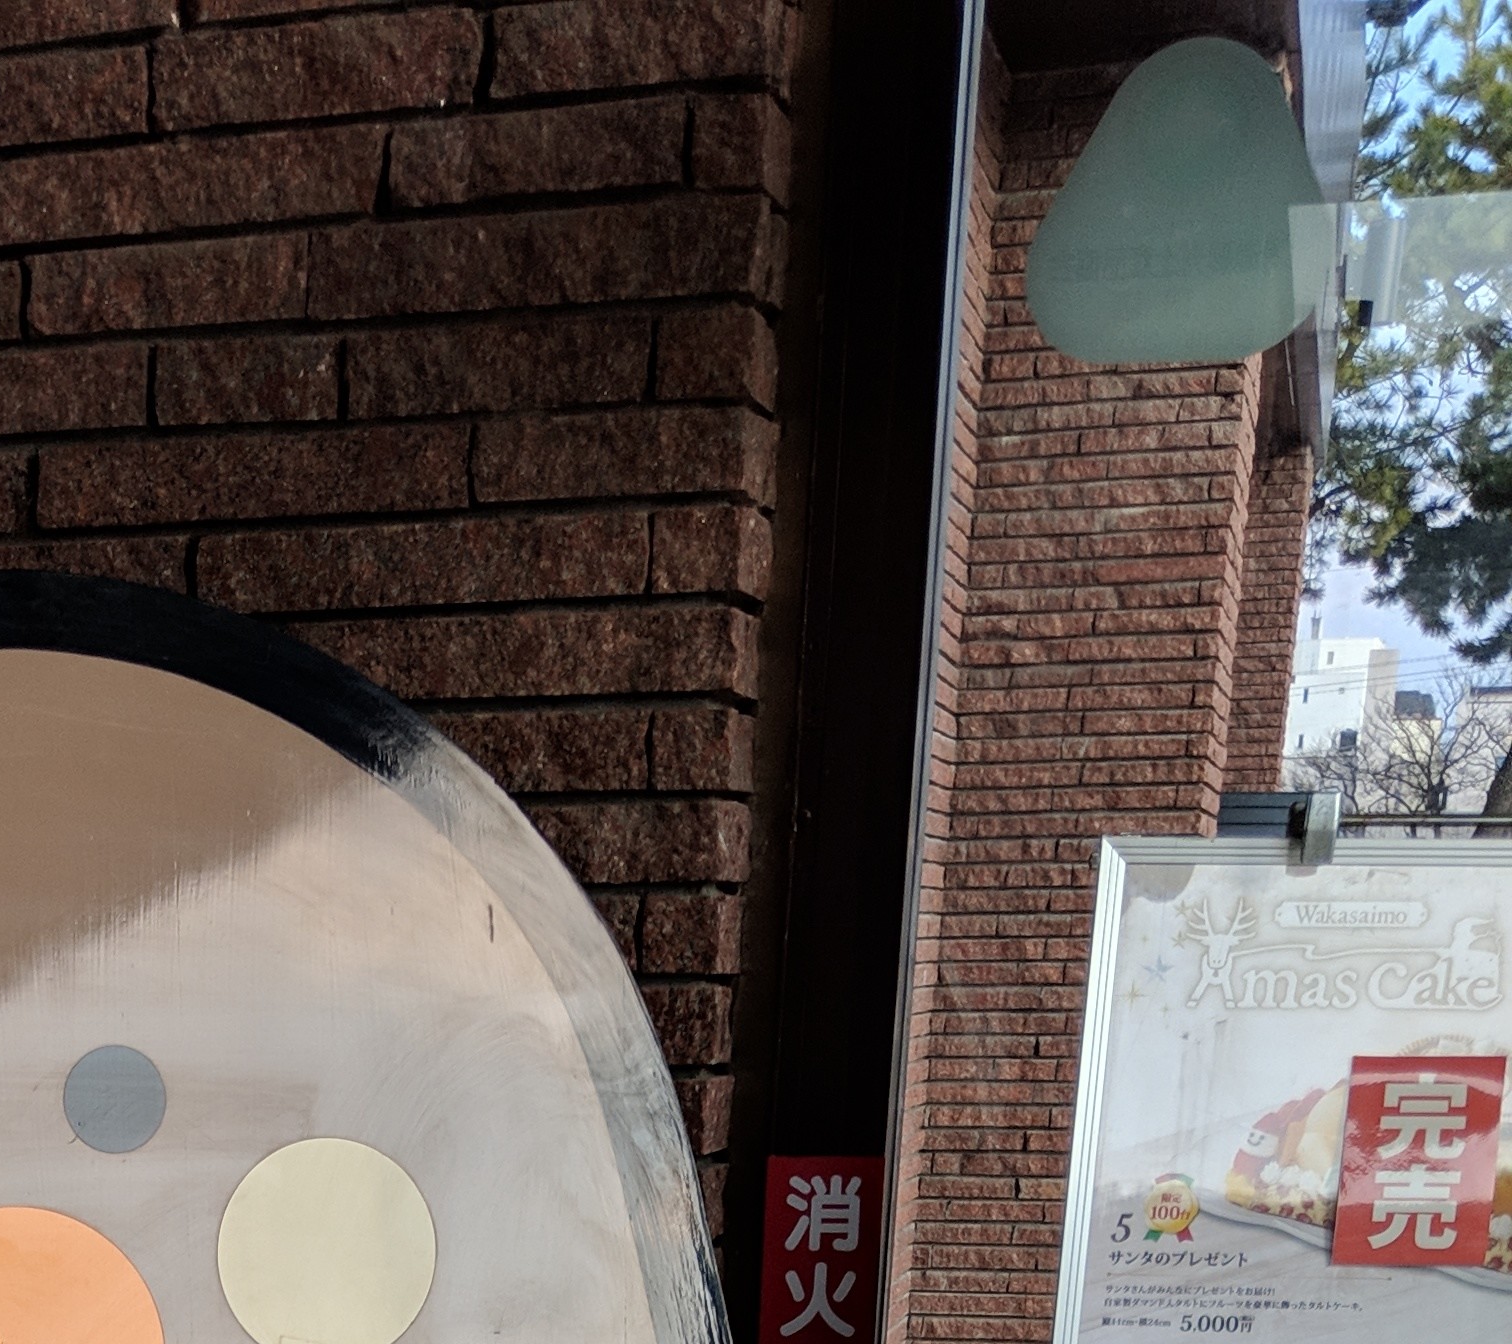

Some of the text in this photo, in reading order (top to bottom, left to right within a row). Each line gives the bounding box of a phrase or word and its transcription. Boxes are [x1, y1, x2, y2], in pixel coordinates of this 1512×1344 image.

[1295, 904, 1408, 925] Wakasaimo
[1368, 957, 1503, 1011] Cake
[1367, 1072, 1468, 1250] 完売
[1160, 1192, 1182, 1204] 限定
[1110, 1213, 1134, 1243] 5
[1108, 1251, 1249, 1268] サンタのプレゼント
